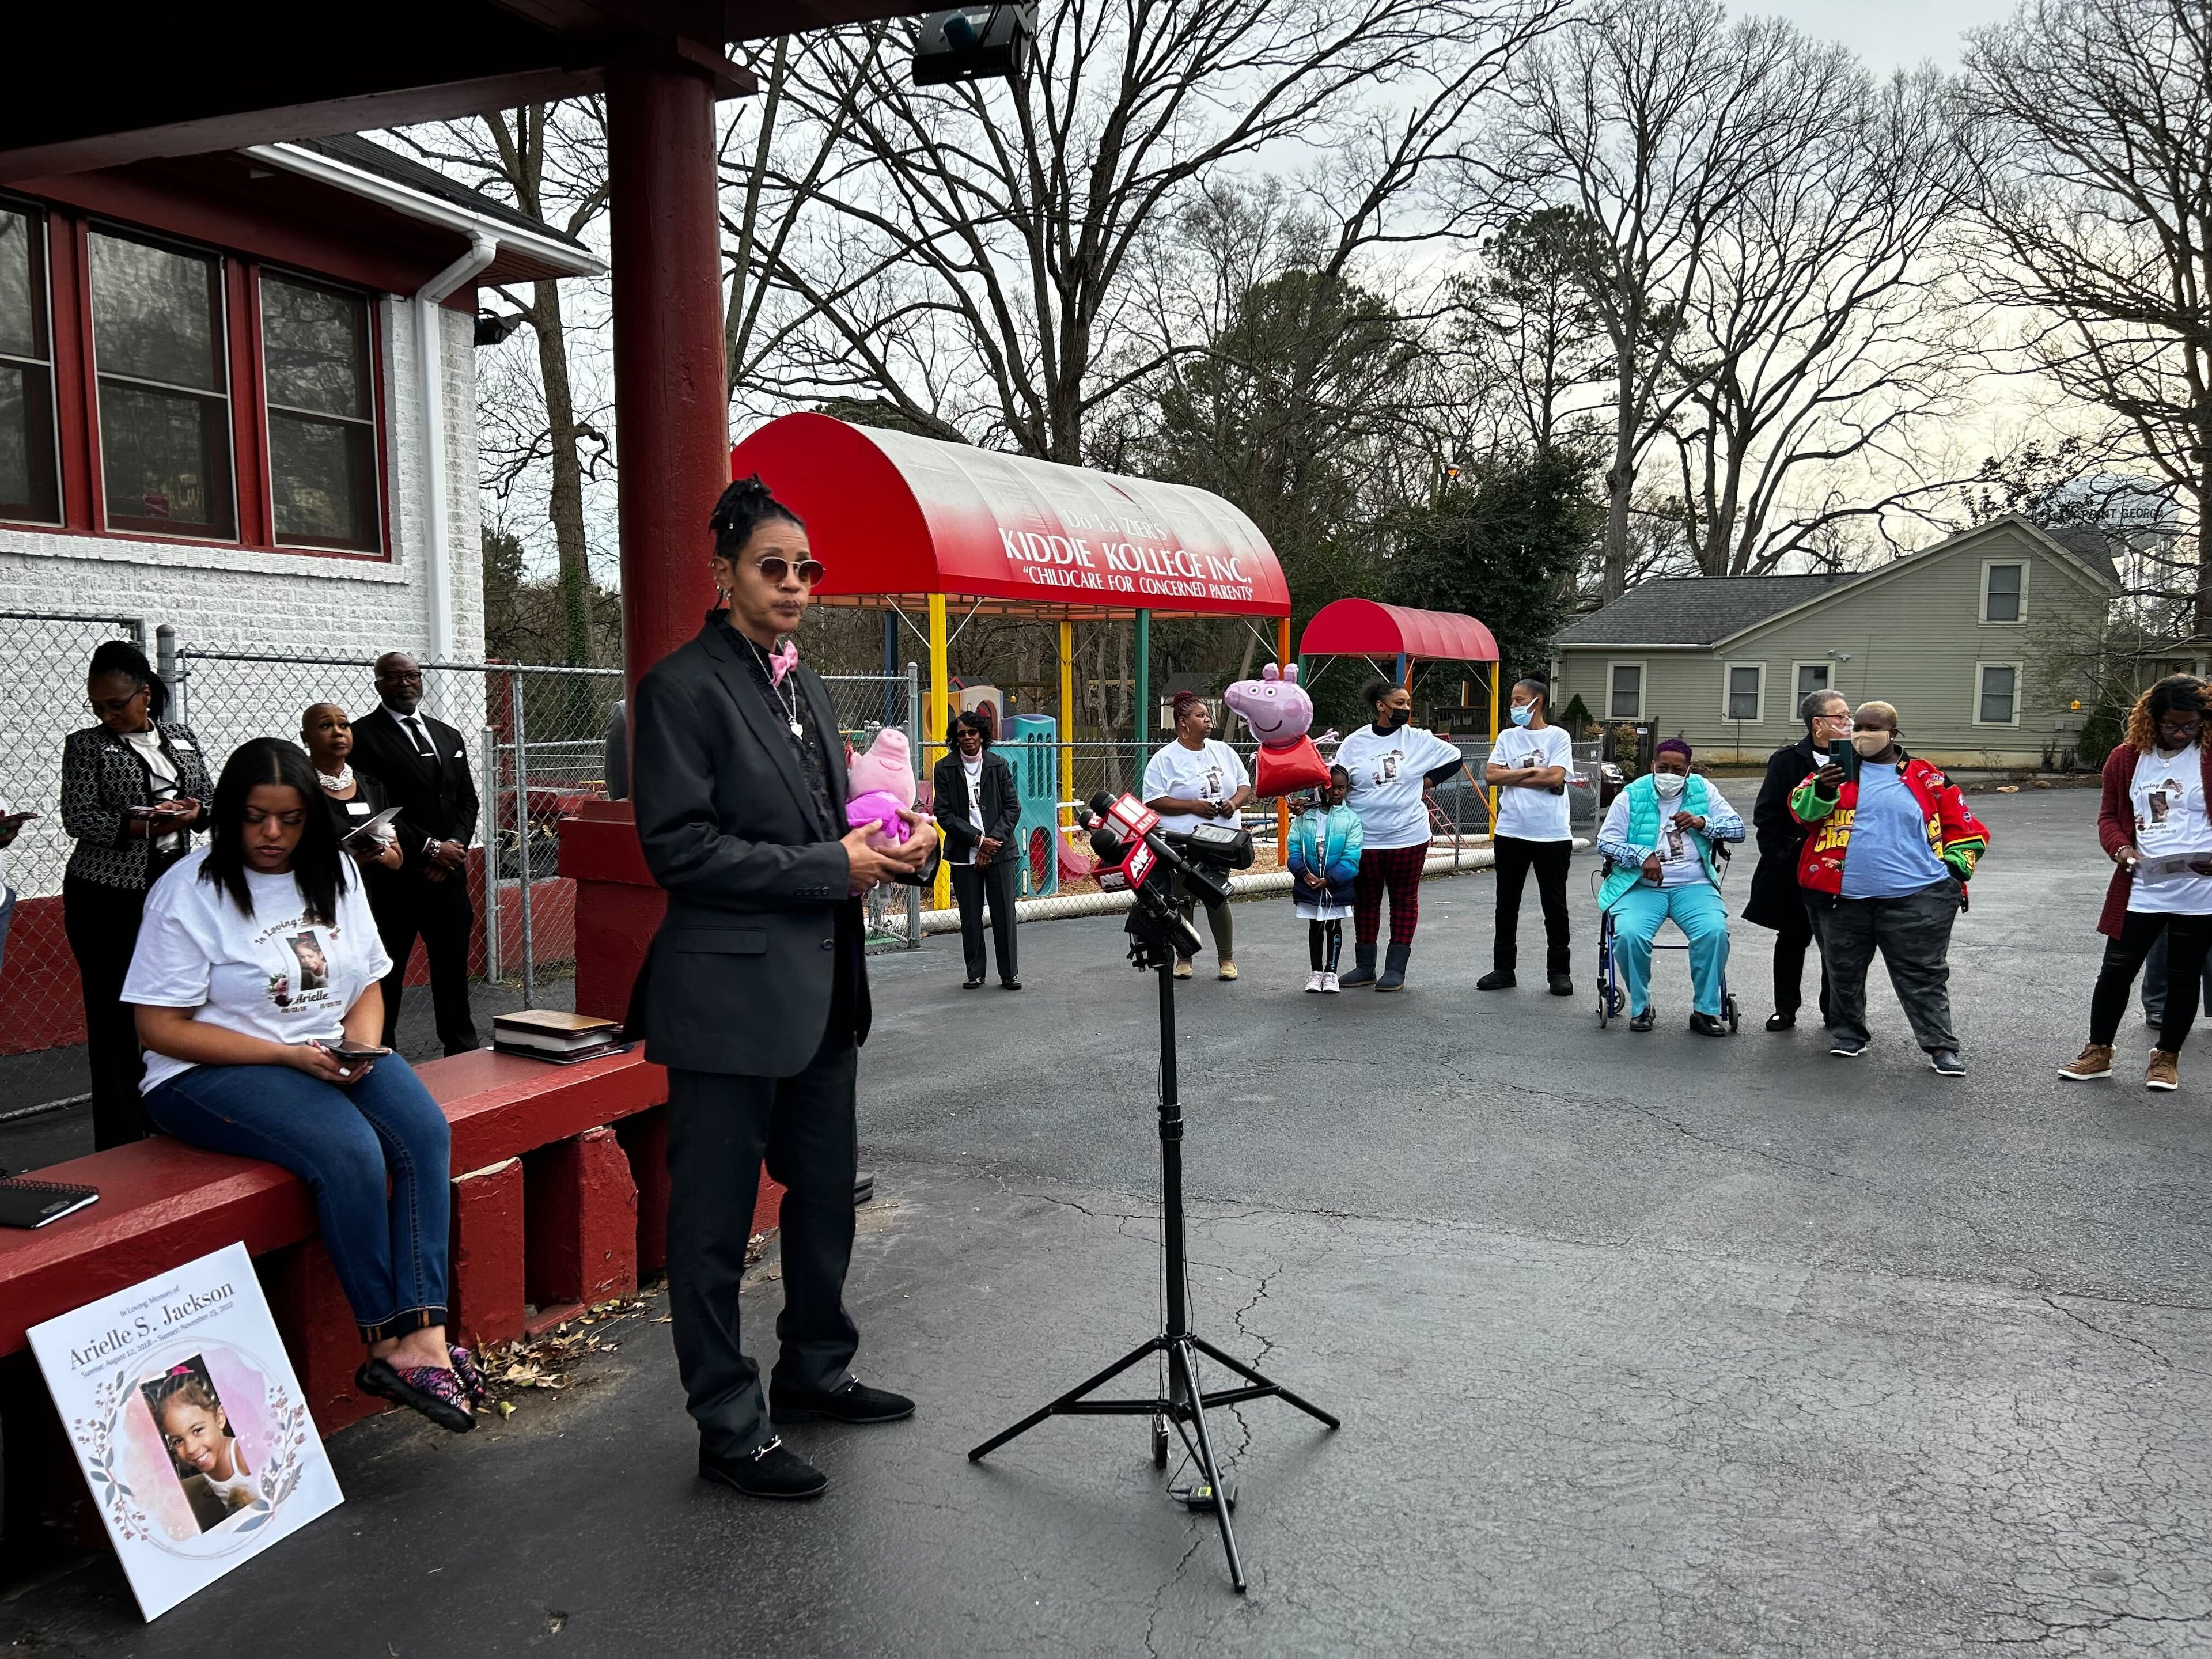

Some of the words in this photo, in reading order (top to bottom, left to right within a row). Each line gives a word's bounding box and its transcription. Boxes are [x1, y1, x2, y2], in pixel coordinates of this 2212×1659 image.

[1063, 509, 1092, 530] Do
[1093, 514, 1119, 533] La
[2122, 508, 2164, 518] GEORGA
[998, 527, 1096, 569] KIDDIE
[1102, 542, 1206, 579] KOLLEGE
[1205, 555, 1253, 584] INC.
[1023, 565, 1105, 589] “CHILDCARE
[1107, 574, 1135, 593] FOR
[1139, 577, 1206, 597] CONCERNED
[1136, 813, 1156, 831] ALIVE
[1130, 842, 1149, 880] ANF
[1100, 871, 1125, 888] ANF
[263, 919, 298, 937] Loving
[294, 990, 329, 1004] Arielle
[127, 1300, 149, 1314] Loving
[148, 1291, 173, 1304] Memory
[172, 1285, 180, 1293] of
[71, 1328, 133, 1370] Arielle
[134, 1316, 157, 1338] S.
[161, 1283, 236, 1325] Jackson
[105, 1352, 127, 1366] August
[180, 1313, 209, 1330] November
